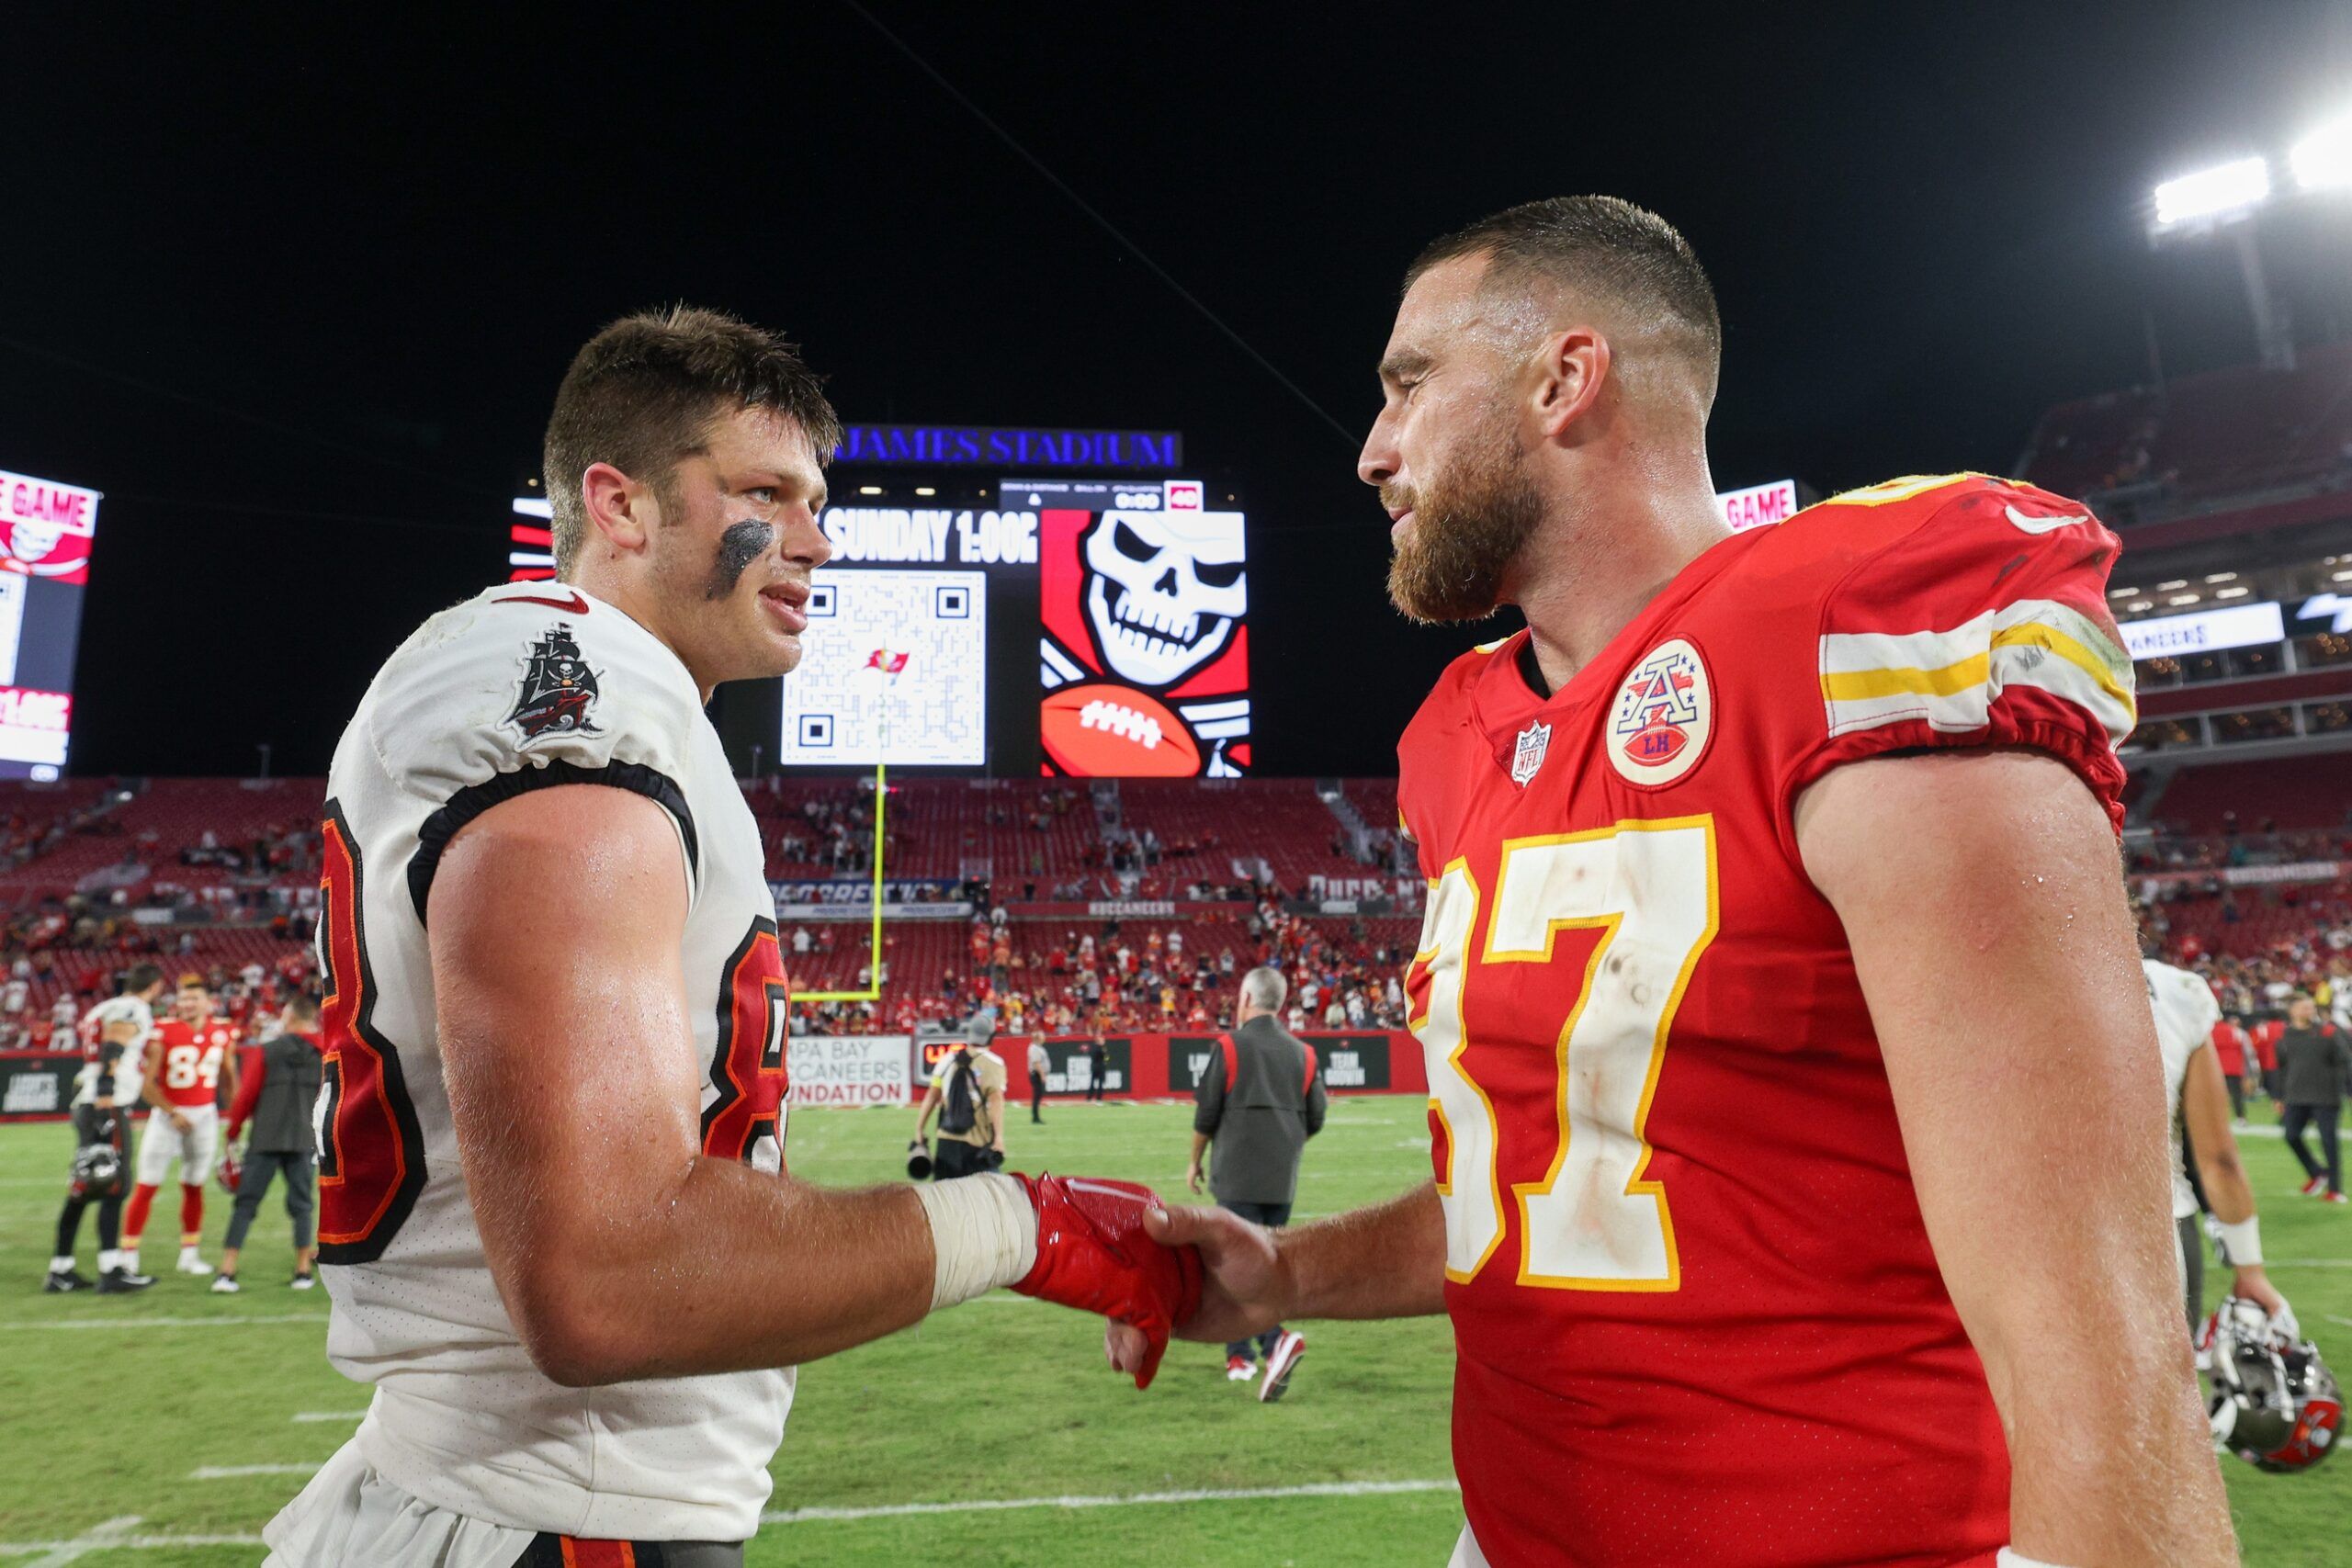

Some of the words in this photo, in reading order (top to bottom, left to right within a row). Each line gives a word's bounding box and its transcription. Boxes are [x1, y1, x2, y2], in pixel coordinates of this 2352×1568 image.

[835, 425, 979, 463] JAMES
[988, 429, 1177, 469] STADIUM
[11, 483, 88, 528] GAME
[1727, 488, 1789, 528] GAME
[824, 508, 953, 562] SUNDAY
[1518, 750, 1541, 774] NFL
[1645, 735, 1668, 754] LH
[166, 1044, 224, 1089] 84
[789, 1061, 901, 1082] CANEERS
[831, 1041, 873, 1060] BAY
[1405, 813, 1720, 1292] 87
